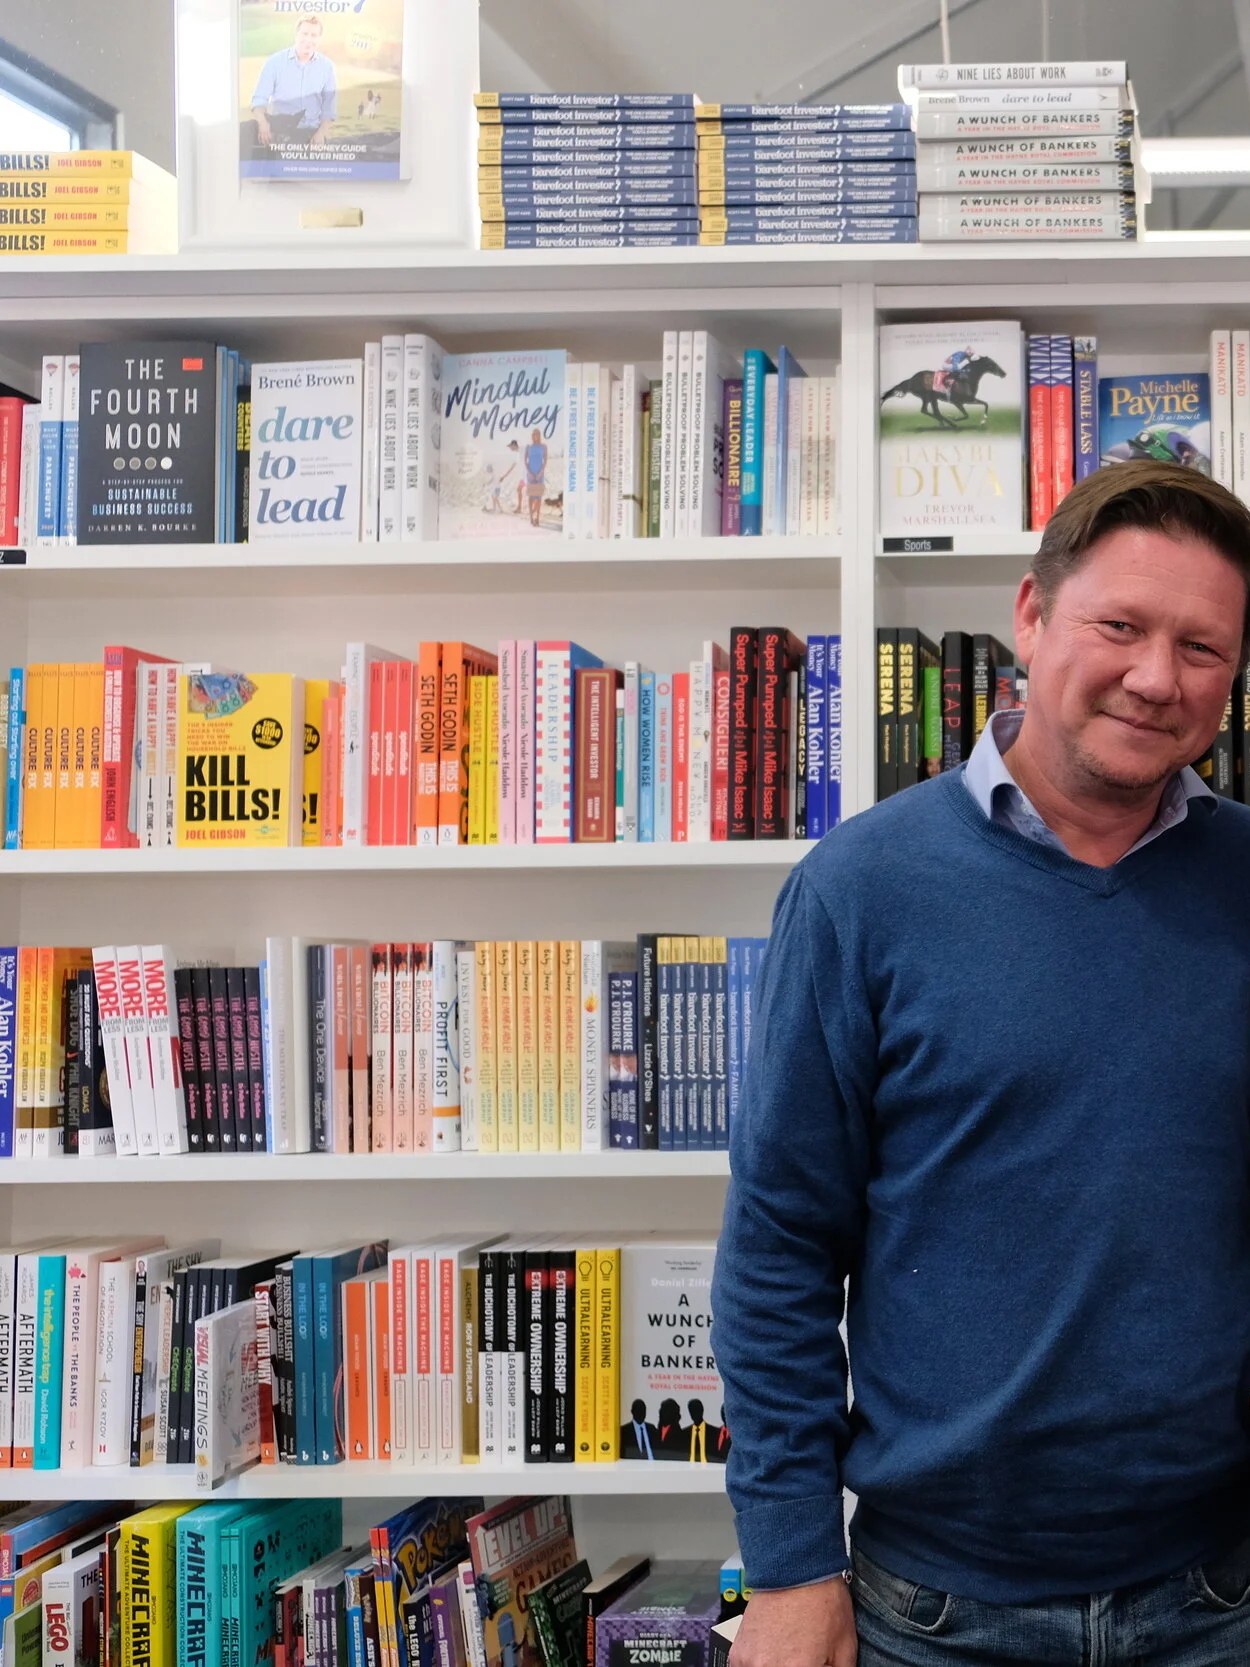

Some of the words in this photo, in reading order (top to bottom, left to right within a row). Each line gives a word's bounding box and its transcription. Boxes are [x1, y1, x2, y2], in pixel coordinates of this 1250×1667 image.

[957, 69, 979, 80] NINE
[983, 69, 1002, 80] LIES
[1006, 68, 1035, 80] ABOUT
[1040, 67, 1066, 79] WORK
[530, 94, 571, 105] barefoot
[572, 94, 613, 105] investor
[957, 117, 965, 125] A
[969, 116, 1017, 124] WUNCH
[1022, 116, 1039, 124] OF
[1043, 114, 1101, 123] BANKERS
[0, 154, 49, 171] BILLS!
[57, 158, 74, 168] JOEL
[76, 158, 102, 168] GIBSON
[269, 144, 287, 153] THE
[289, 144, 309, 153] ONLY
[310, 144, 338, 153] MONEY
[340, 144, 367, 153] GUIDE
[306, 152, 328, 160] EVER
[330, 152, 356, 160] NEED
[125, 359, 164, 380] THE
[258, 374, 303, 389] Brené
[306, 373, 355, 387] Brown
[1216, 342, 1226, 396] MANIKATO
[90, 388, 199, 415] FOURTH
[445, 369, 552, 418] Mindful
[1080, 370, 1092, 419] STABLE
[1139, 380, 1199, 394] Michelle
[470, 402, 562, 439] Money
[1110, 388, 1199, 423] Payne
[105, 423, 181, 449] MOON
[258, 406, 354, 442] dare
[1080, 422, 1092, 454] LASS
[728, 400, 741, 487] BILLIONAIRE
[259, 451, 296, 480] to
[894, 466, 1003, 497] DIVA
[92, 504, 142, 516] BUSINESS
[147, 503, 193, 515] SUCCESS
[108, 488, 177, 500] SUSTAINABLE
[256, 485, 347, 524] lead
[904, 539, 932, 551] Sports
[735, 634, 749, 672] Super
[421, 675, 435, 707] SETH
[591, 681, 600, 693] THE
[879, 643, 894, 716] SERENA
[734, 675, 749, 729] Pumped
[808, 685, 823, 723] Alan
[943, 668, 960, 728] LEAP
[421, 712, 435, 753] GODIN
[591, 696, 599, 741] INTELLIGENT
[716, 676, 730, 770] CONSIGLIERI
[29, 727, 37, 771] CULTURE
[590, 744, 599, 779] INVESTOR
[808, 726, 824, 784] Kohler
[28, 772, 37, 789] FIX
[186, 755, 250, 786] KILL
[734, 751, 747, 784] Mike
[185, 789, 281, 822] BILLS!
[734, 787, 747, 819] Isaac
[186, 829, 206, 840] JOEL
[210, 828, 246, 840] GIBSON
[644, 948, 652, 976] Future
[94, 959, 120, 1020] MORE
[644, 978, 652, 1016] Histories
[101, 1018, 121, 1026] FROM
[103, 1025, 121, 1034] LESS
[436, 1001, 448, 1051] PROFIT
[376, 1050, 385, 1070] Ben
[436, 1057, 447, 1097] FIRST
[376, 1074, 385, 1117] Mezrich
[531, 1271, 542, 1321] EXTREME
[679, 1294, 689, 1307] A
[580, 1289, 590, 1369] ULTRALEARNING
[648, 1314, 714, 1328] WUNCH
[18, 1314, 34, 1393] AFTERMATH
[672, 1334, 696, 1348] OF
[530, 1322, 542, 1395] OWNERSHIP
[641, 1354, 715, 1368] BANKER
[197, 1367, 209, 1449] MEETINGS
[476, 1514, 532, 1571] LEVEL
[535, 1502, 568, 1539] UP!
[45, 1604, 69, 1652] LEGO
[624, 1640, 688, 1648] MINECRAFT
[629, 1649, 682, 1664] ZOMBIE
